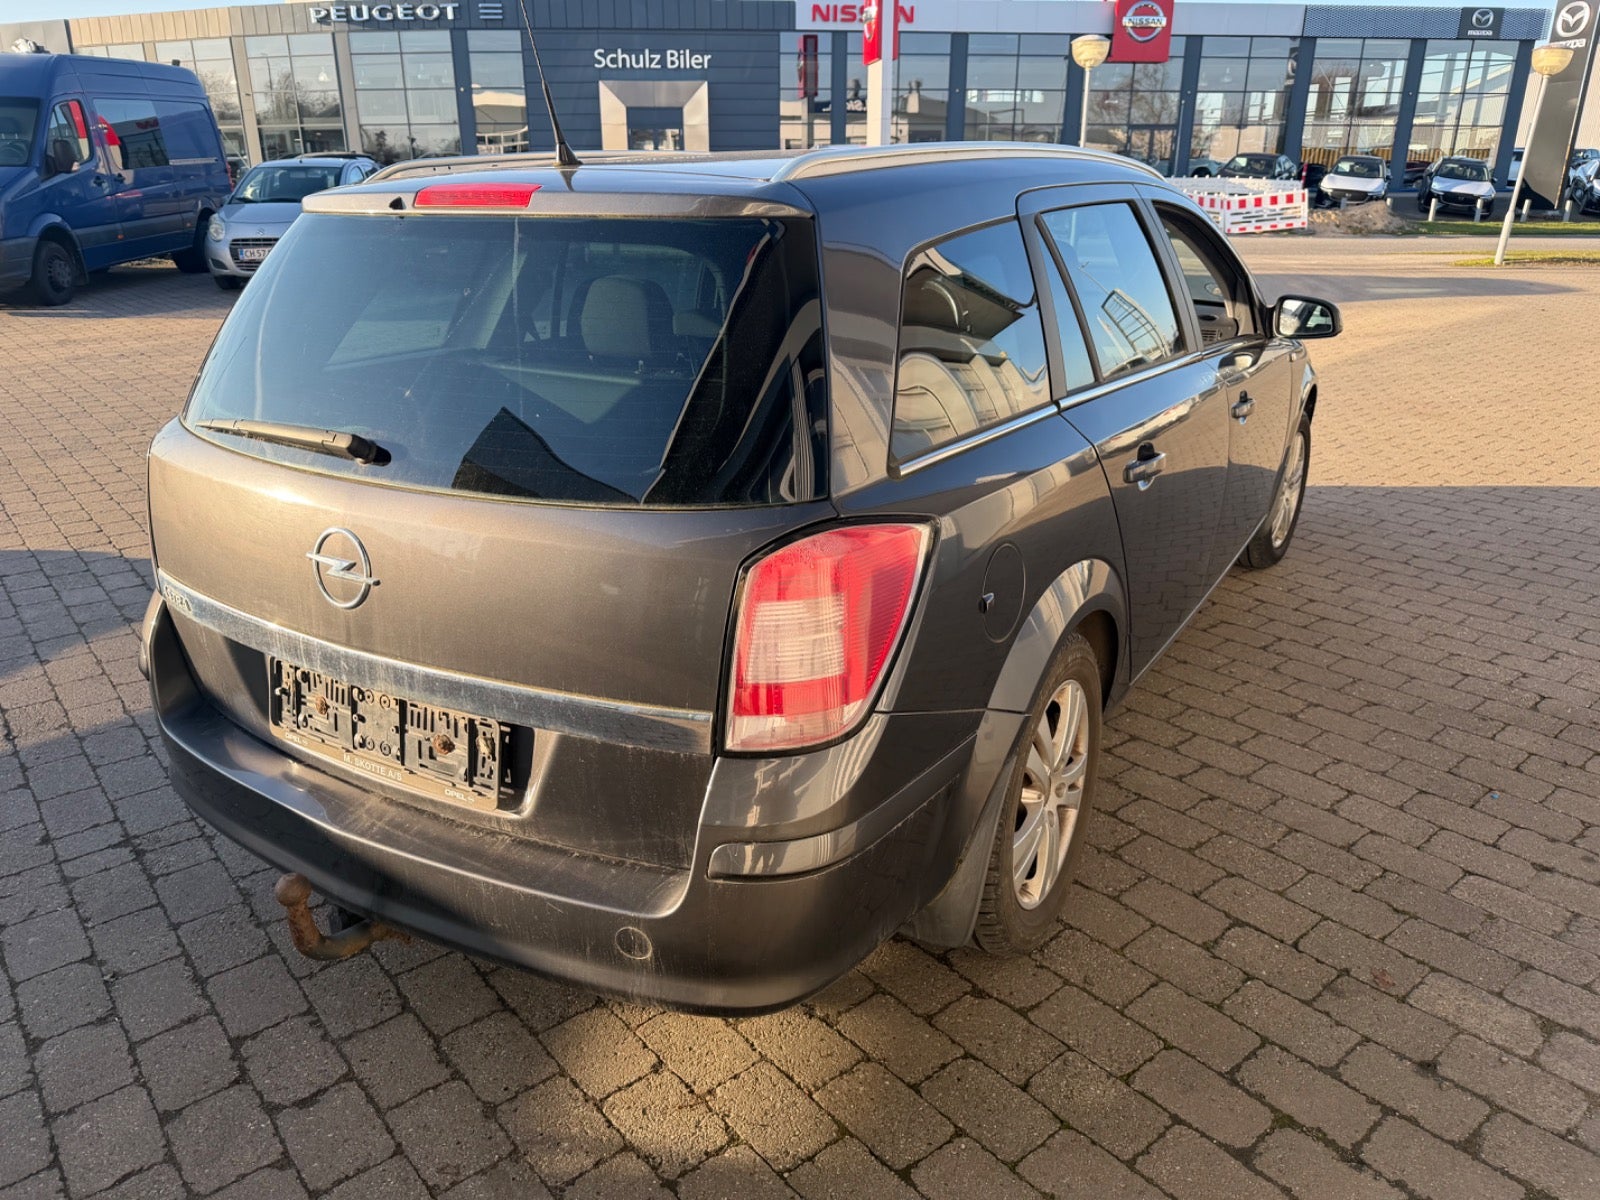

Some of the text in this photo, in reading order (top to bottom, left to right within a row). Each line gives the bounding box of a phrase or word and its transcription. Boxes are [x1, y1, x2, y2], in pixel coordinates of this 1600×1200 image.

[309, 3, 458, 24] PEUGEOT
[812, 4, 915, 24] NISN
[593, 48, 712, 69] Schulz Biler
[444, 788, 468, 801] OPEL
